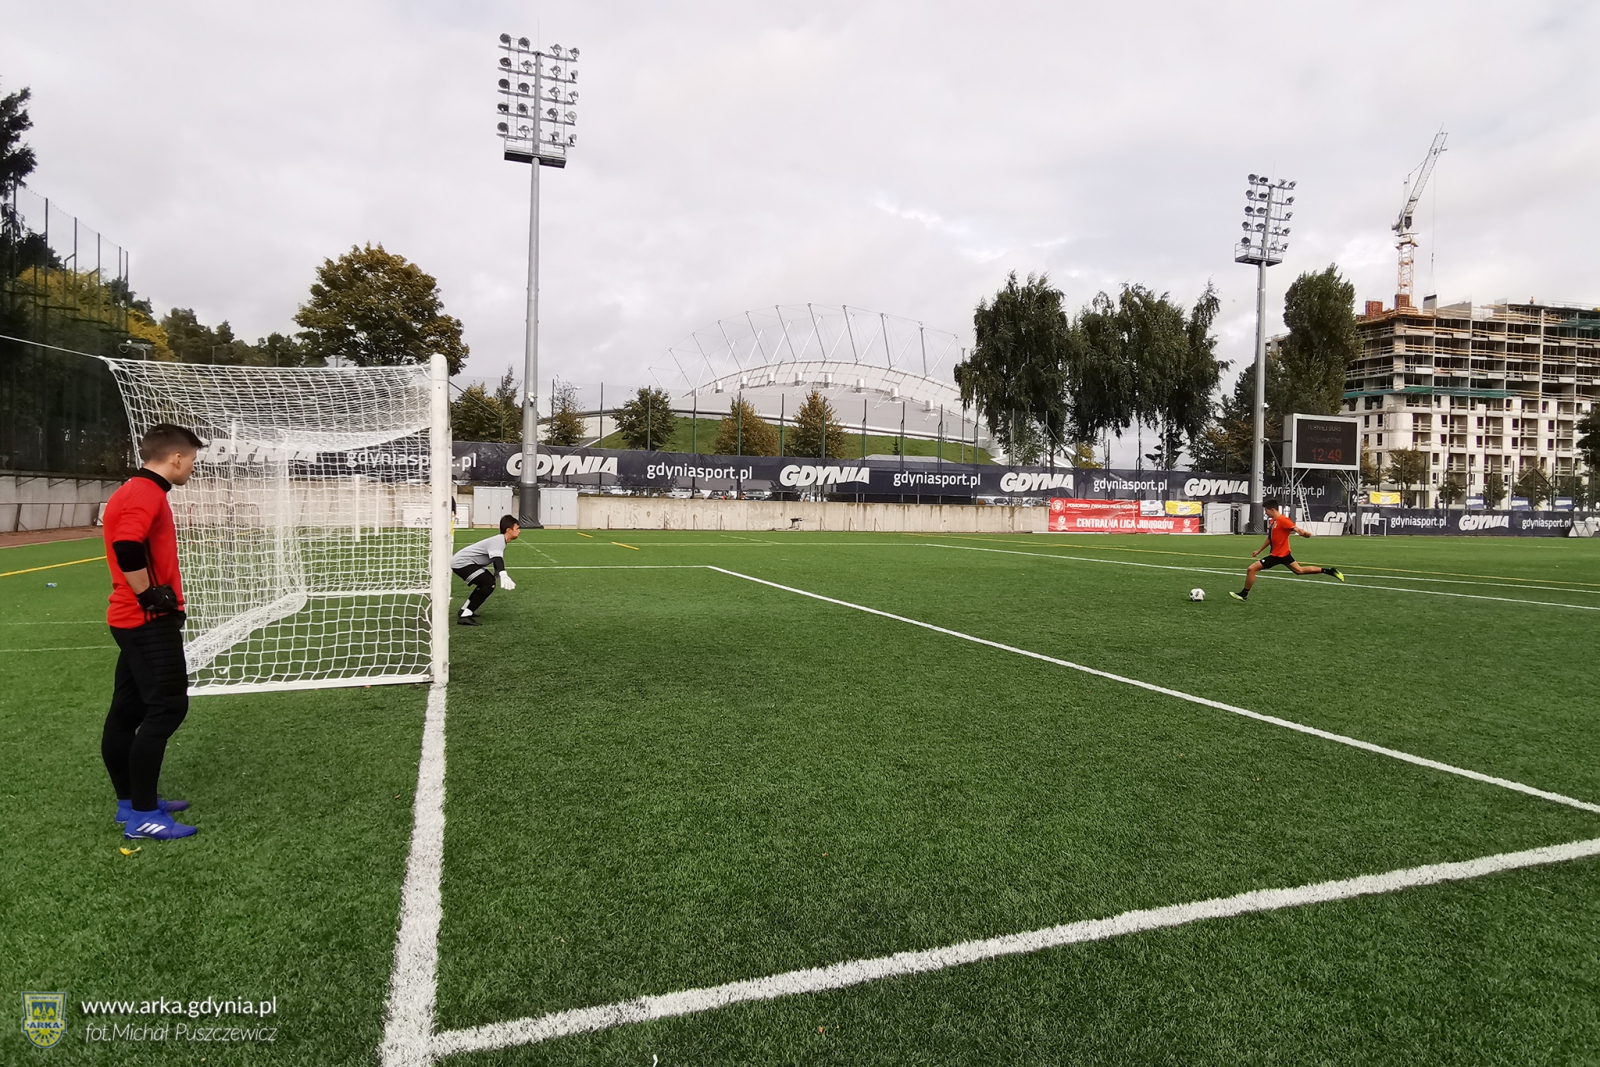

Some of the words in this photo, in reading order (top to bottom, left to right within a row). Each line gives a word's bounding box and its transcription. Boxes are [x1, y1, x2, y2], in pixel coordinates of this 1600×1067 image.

[1311, 448, 1342, 462] 12:49
[506, 453, 618, 476] GDYNIA
[647, 462, 753, 482] gdyniasport.pl
[780, 464, 870, 486] GDYNIA
[893, 471, 981, 489] gdyniasport.pl
[1000, 472, 1074, 493] GDYNIA
[1093, 478, 1168, 494] gdyniasport.pl
[1183, 478, 1249, 497] GDYNIA
[1076, 518, 1119, 528] CENTRALNA
[1119, 519, 1135, 529] LIGA
[1390, 515, 1447, 529] gdyniasport.pl
[1458, 515, 1510, 531] GDYNIA
[1521, 517, 1573, 530] gdyniasport.pl
